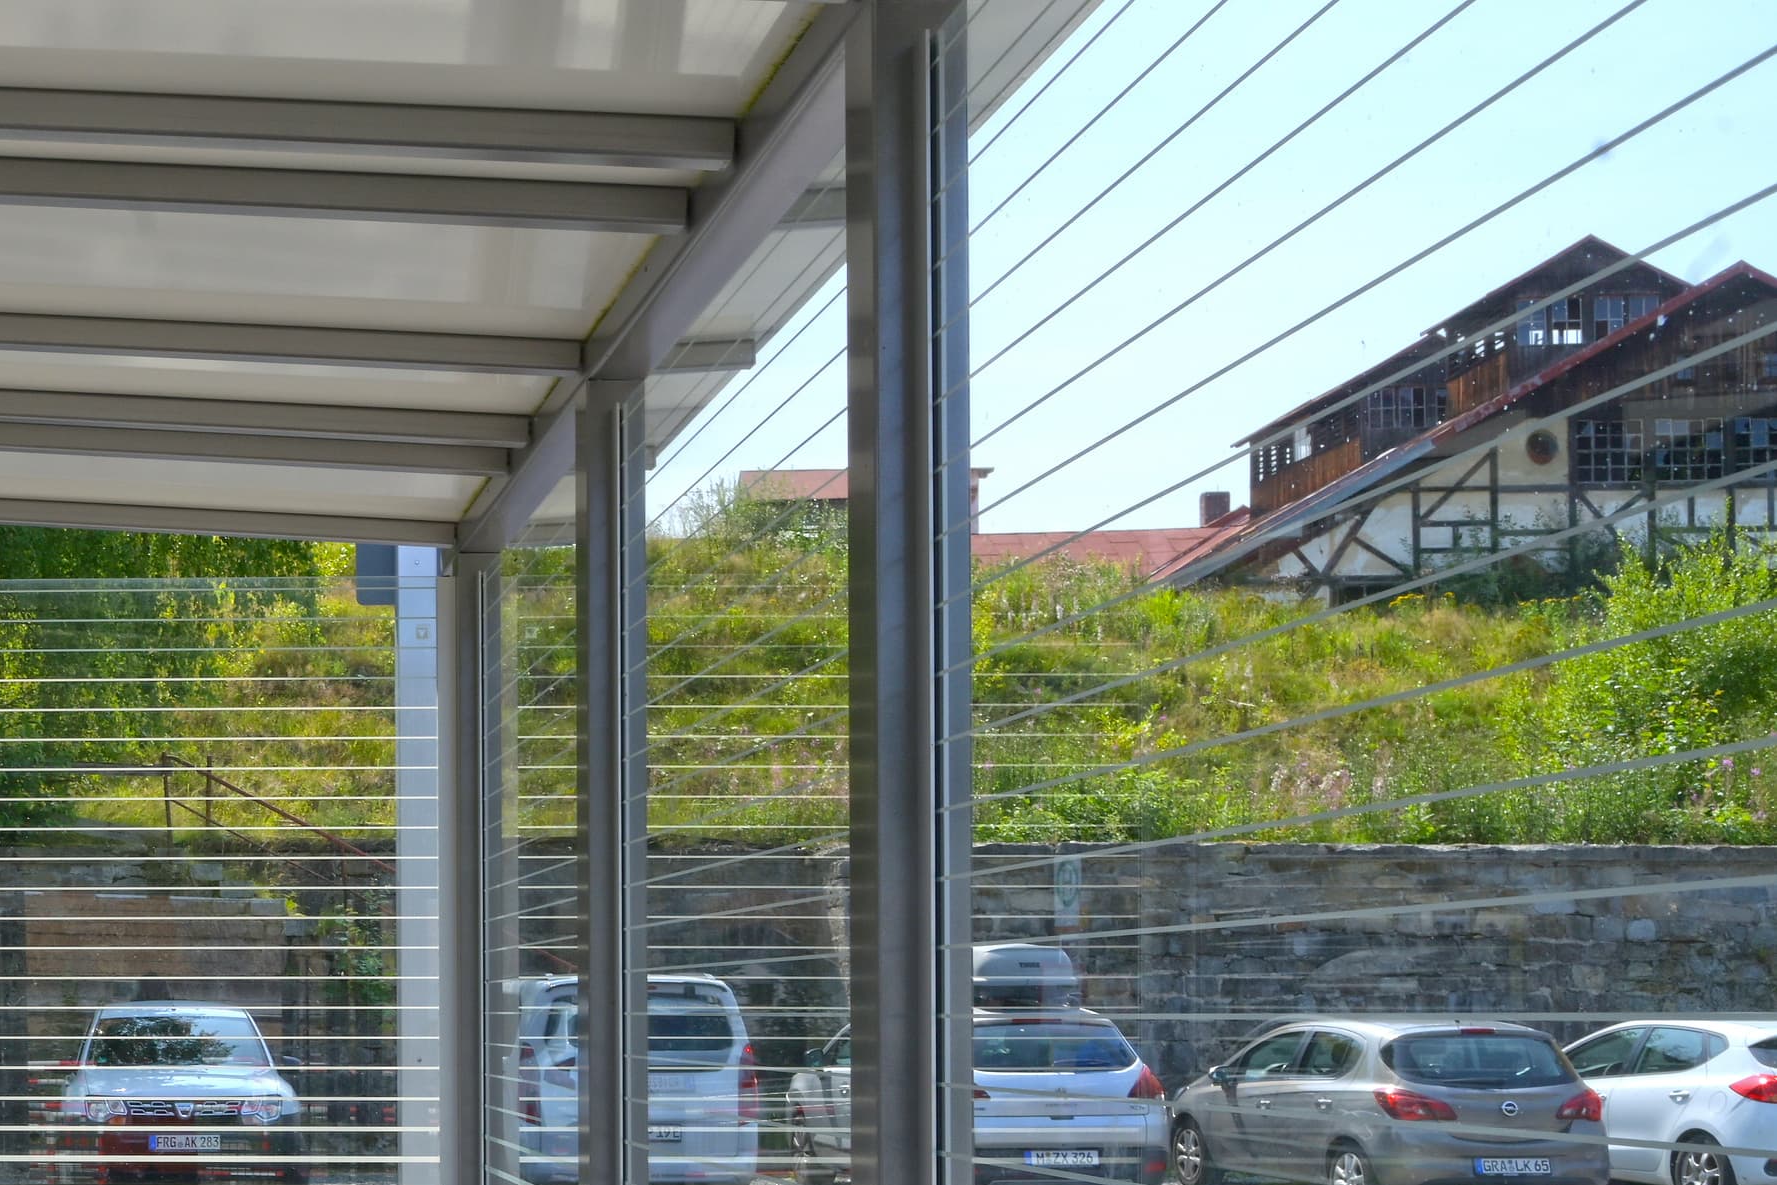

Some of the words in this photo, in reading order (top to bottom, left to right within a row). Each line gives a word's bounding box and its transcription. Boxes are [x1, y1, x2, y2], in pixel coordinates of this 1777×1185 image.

[156, 1136, 177, 1148] FRG
[184, 1136, 198, 1148] AK
[200, 1136, 219, 1148] 283
[1036, 1152, 1045, 1165] M
[1052, 1152, 1069, 1164] ZX
[1071, 1152, 1094, 1164] 326
[1483, 1160, 1507, 1172] GRA
[1515, 1160, 1532, 1172] LK
[1534, 1160, 1550, 1172] 65
